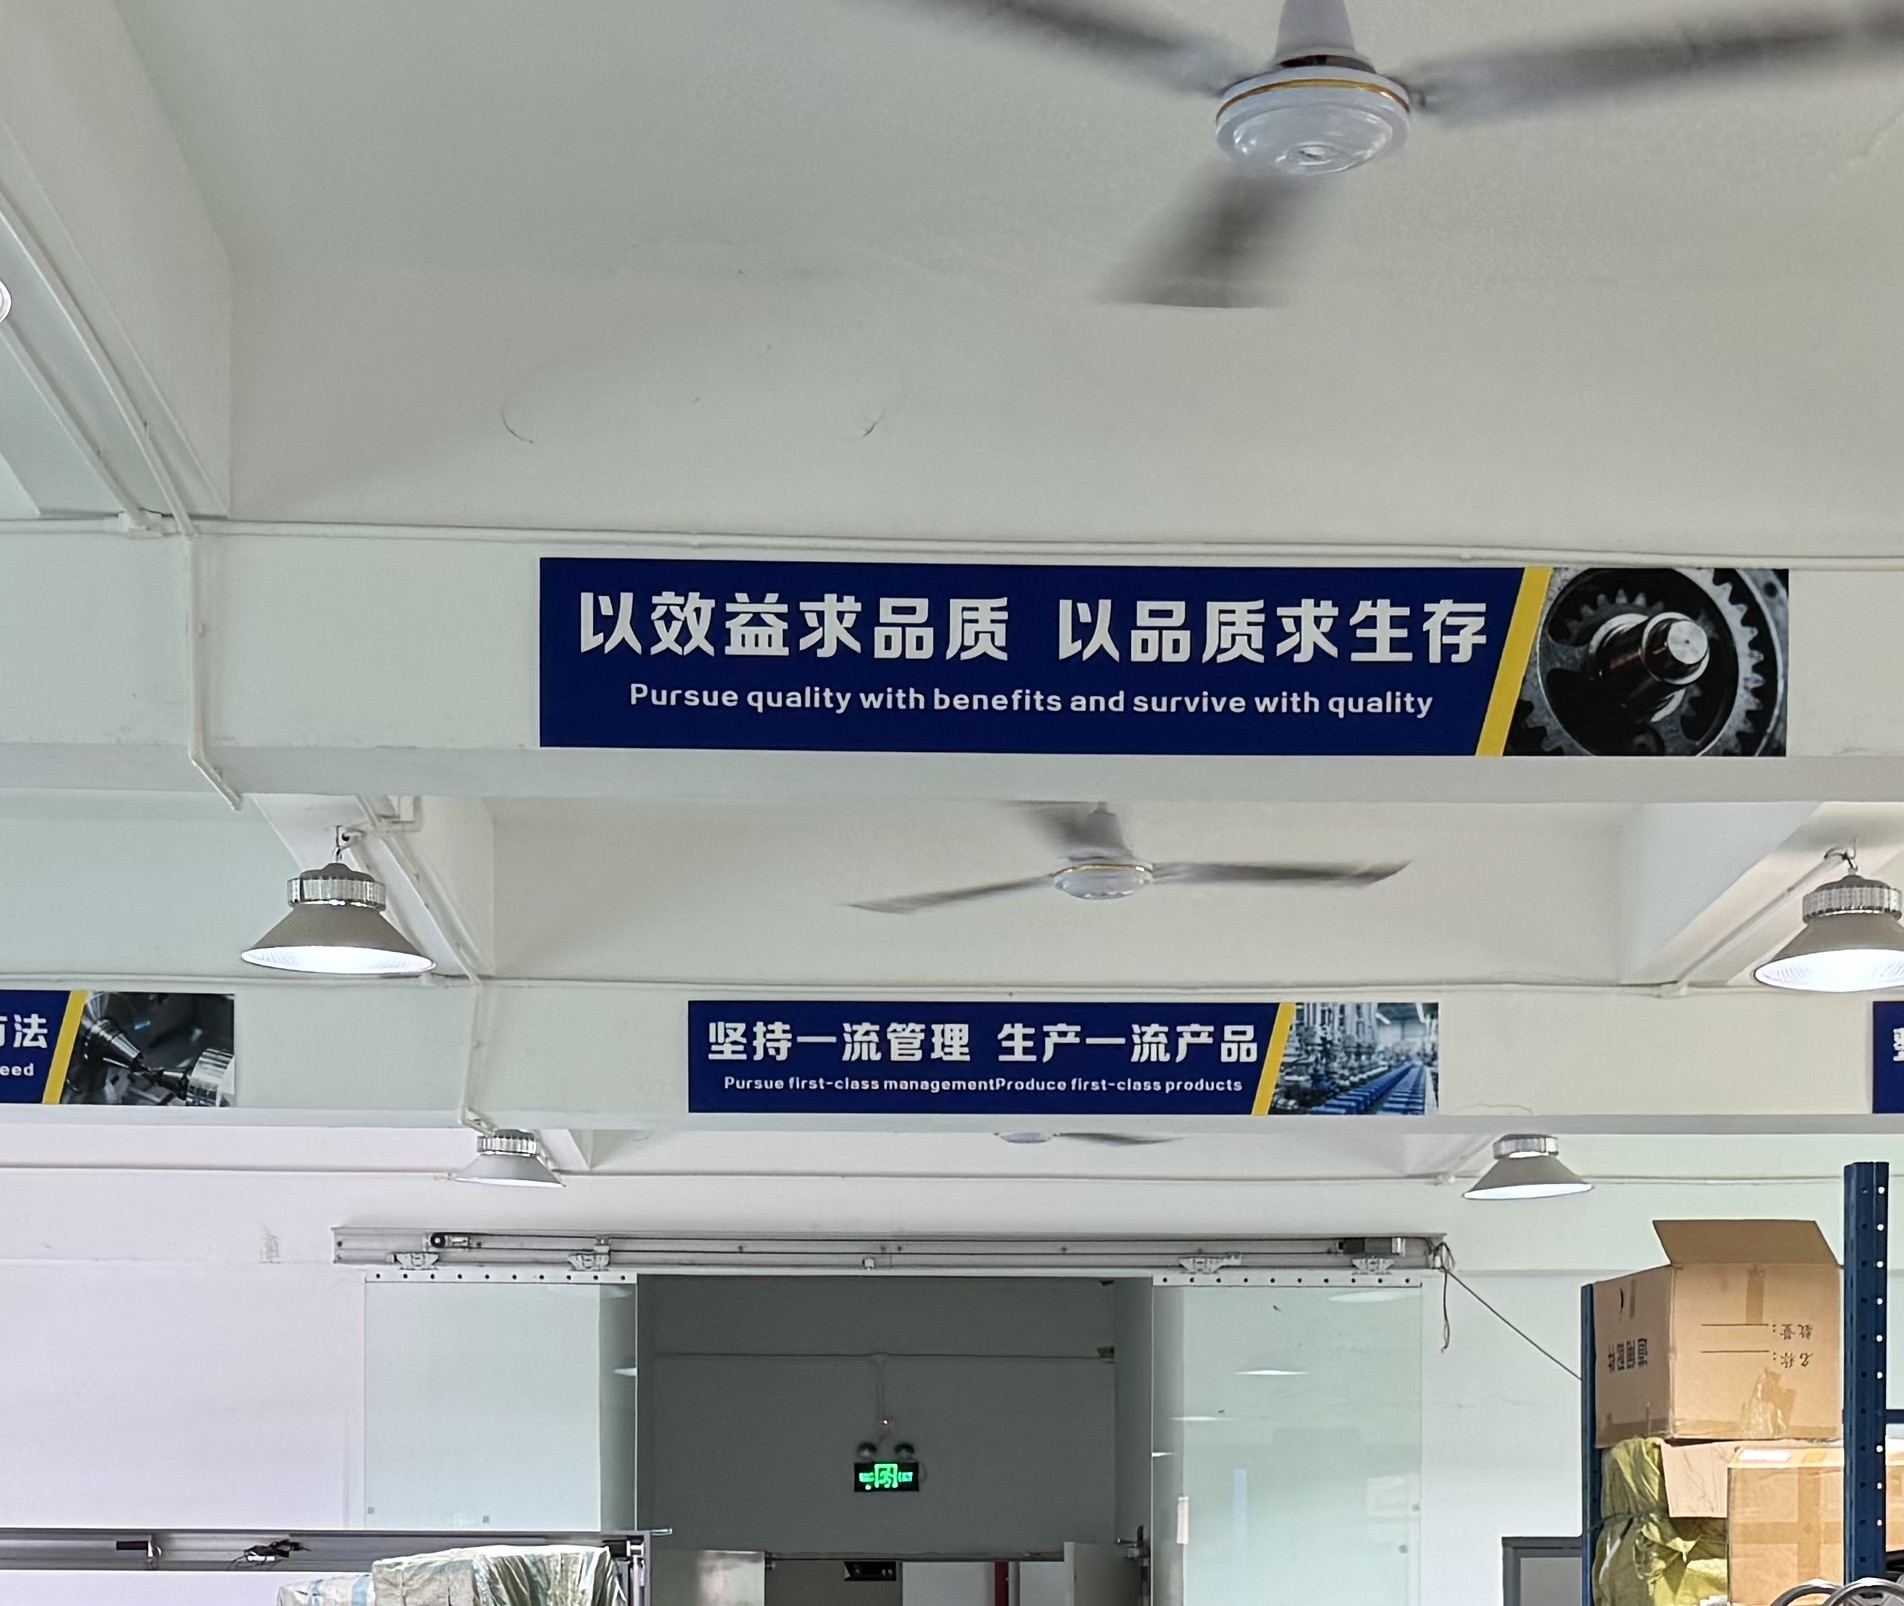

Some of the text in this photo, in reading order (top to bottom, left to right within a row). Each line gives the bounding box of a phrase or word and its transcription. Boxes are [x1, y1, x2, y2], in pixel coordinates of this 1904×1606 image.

[581, 592, 1486, 663] 以效益求品质 以品质求生存
[631, 683, 1433, 719] Pursue quality with benefits and survive with quality
[707, 1021, 1258, 1064] 坚持一流管理 生产一流产品
[724, 1076, 1243, 1094] Pursue first-class managementProduce first-class products
